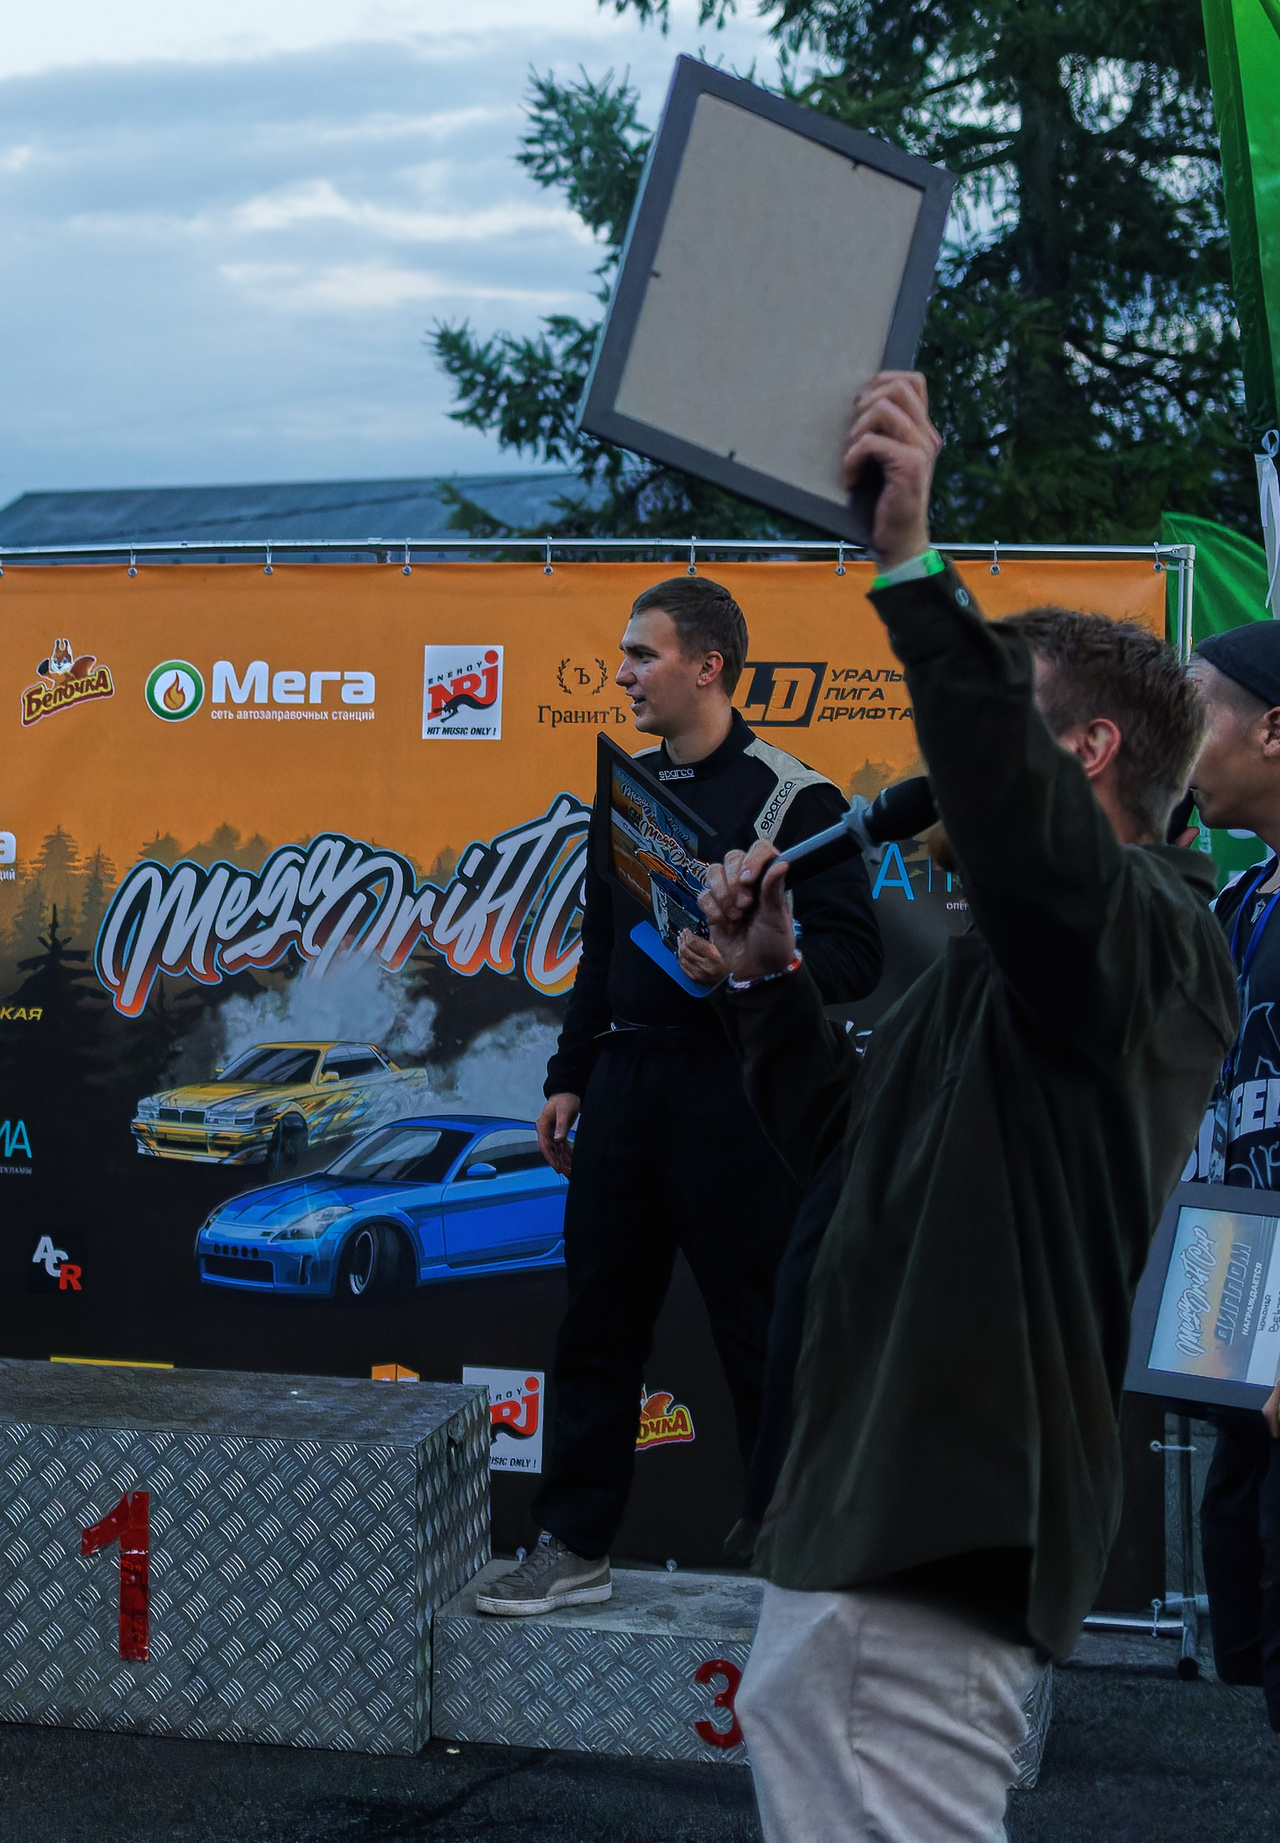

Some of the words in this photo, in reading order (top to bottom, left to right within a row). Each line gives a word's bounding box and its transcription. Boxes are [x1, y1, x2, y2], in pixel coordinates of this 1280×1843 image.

[211, 660, 376, 704] Мега
[831, 668, 906, 683] УРАЛЬ
[731, 667, 817, 722] LD
[824, 687, 885, 701] ЛИГА
[211, 709, 234, 720] сеть
[236, 709, 329, 722] автозаправочных
[331, 708, 375, 722] станций
[537, 705, 627, 728] ГранитЪ
[817, 706, 915, 723] ДРИФТА
[426, 726, 441, 736] HIT
[441, 726, 468, 736] MUSIC
[470, 726, 492, 736] ONLY
[658, 767, 695, 781] sparco
[760, 780, 796, 833] sparco
[1241, 1261, 1263, 1337] НАГРАЖДАЕТСЯ
[81, 1490, 150, 1662] 1
[693, 1659, 742, 1748] 3
